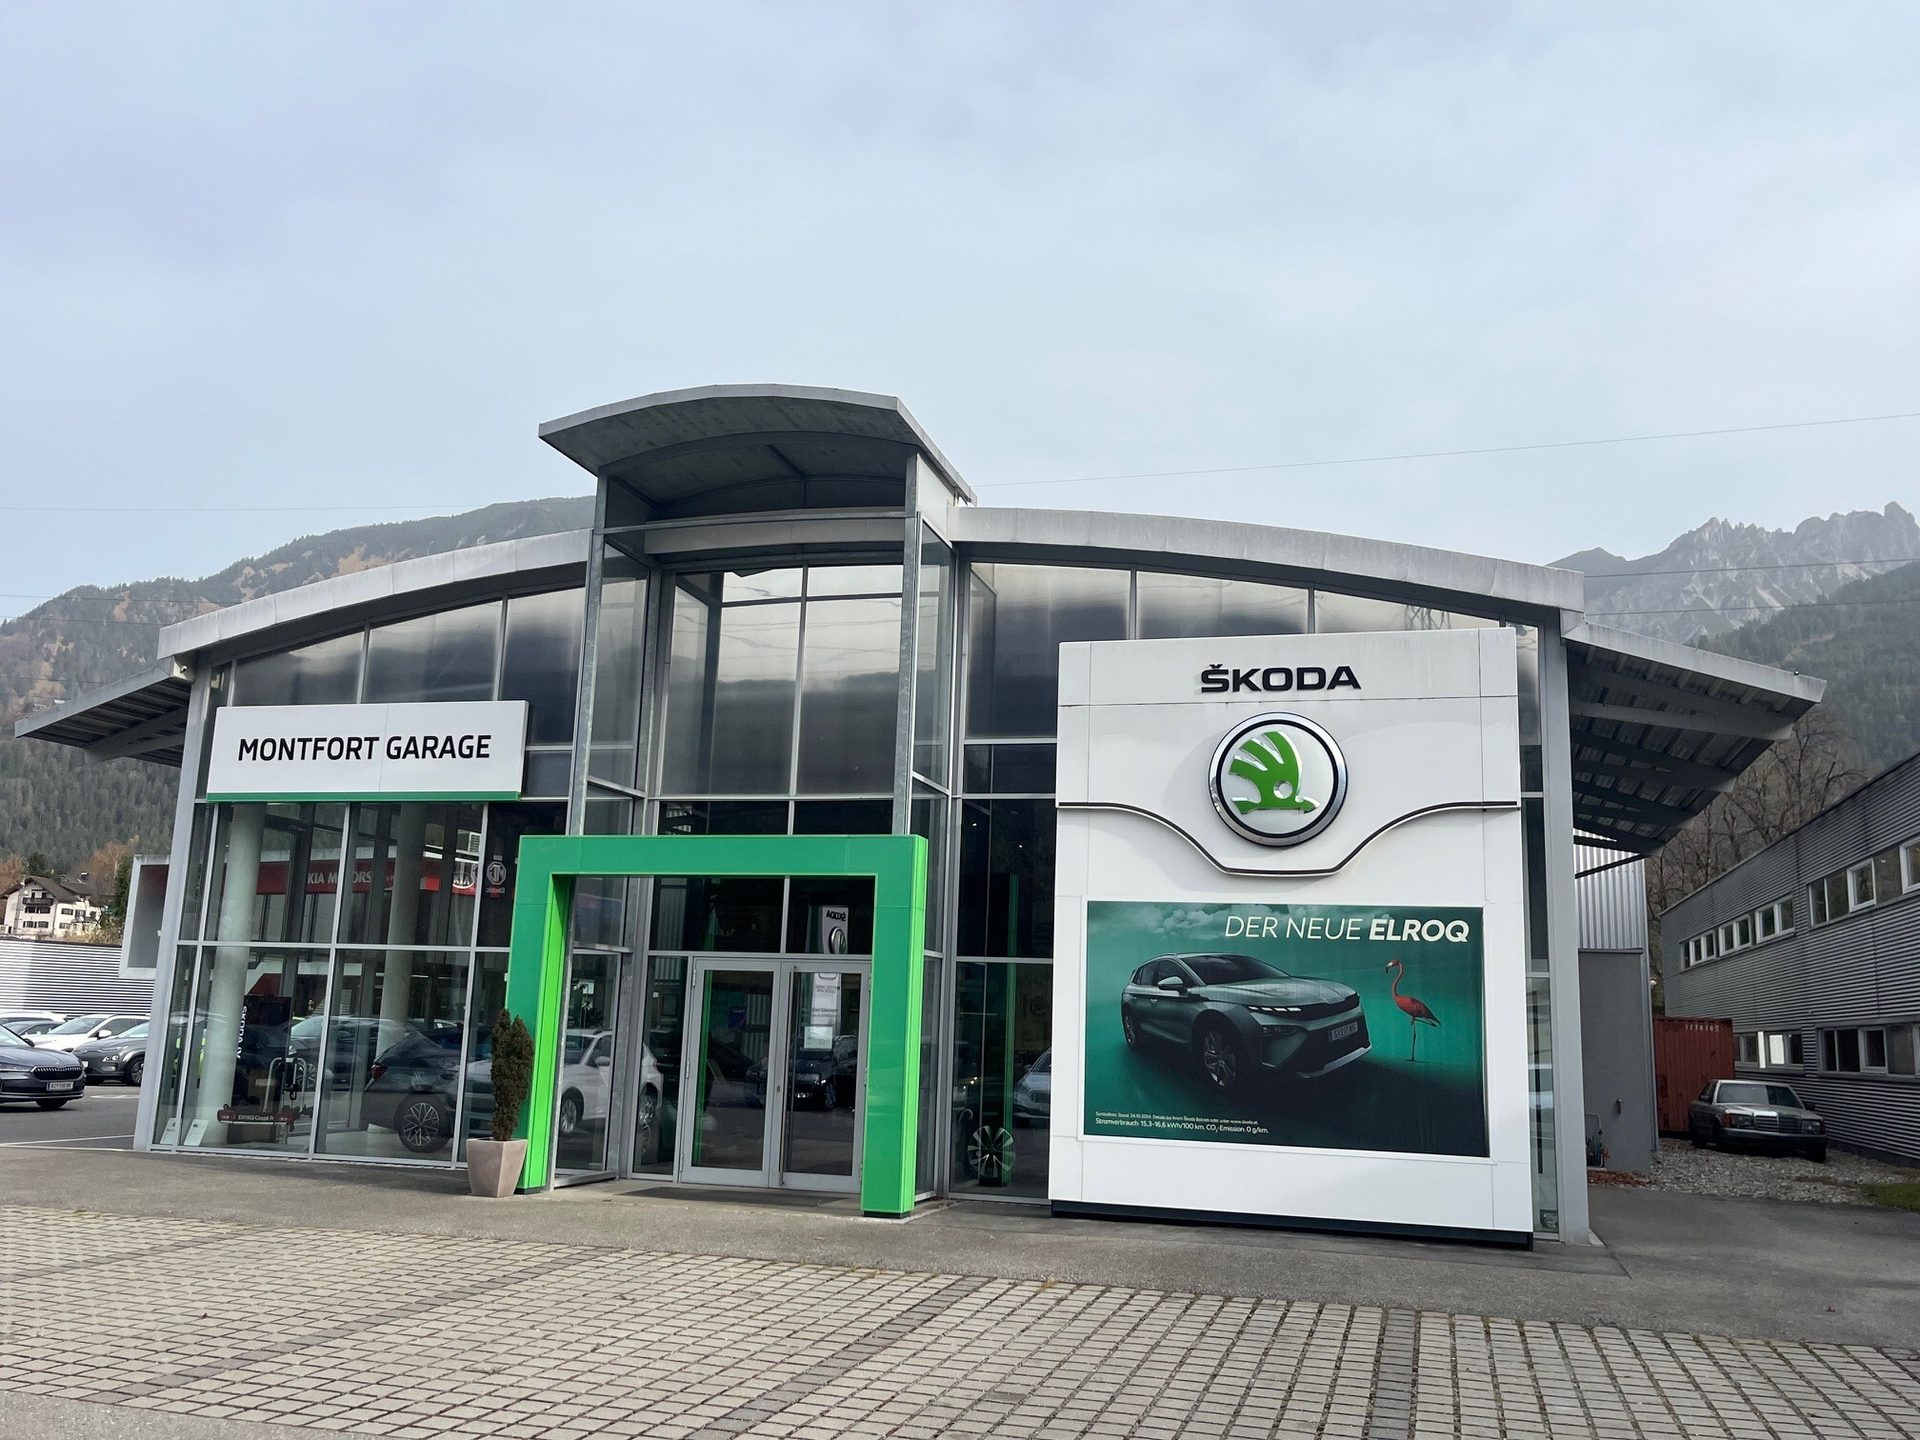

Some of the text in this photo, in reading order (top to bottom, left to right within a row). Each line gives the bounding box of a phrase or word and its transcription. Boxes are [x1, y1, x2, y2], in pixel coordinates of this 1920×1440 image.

[1201, 664, 1361, 693] ŠKODA
[238, 735, 491, 761] MONTFORT GARAGE
[307, 871, 325, 885] KIA
[1225, 916, 1470, 943] DER NEUE ELROQ
[1246, 1125, 1252, 1133] 0
